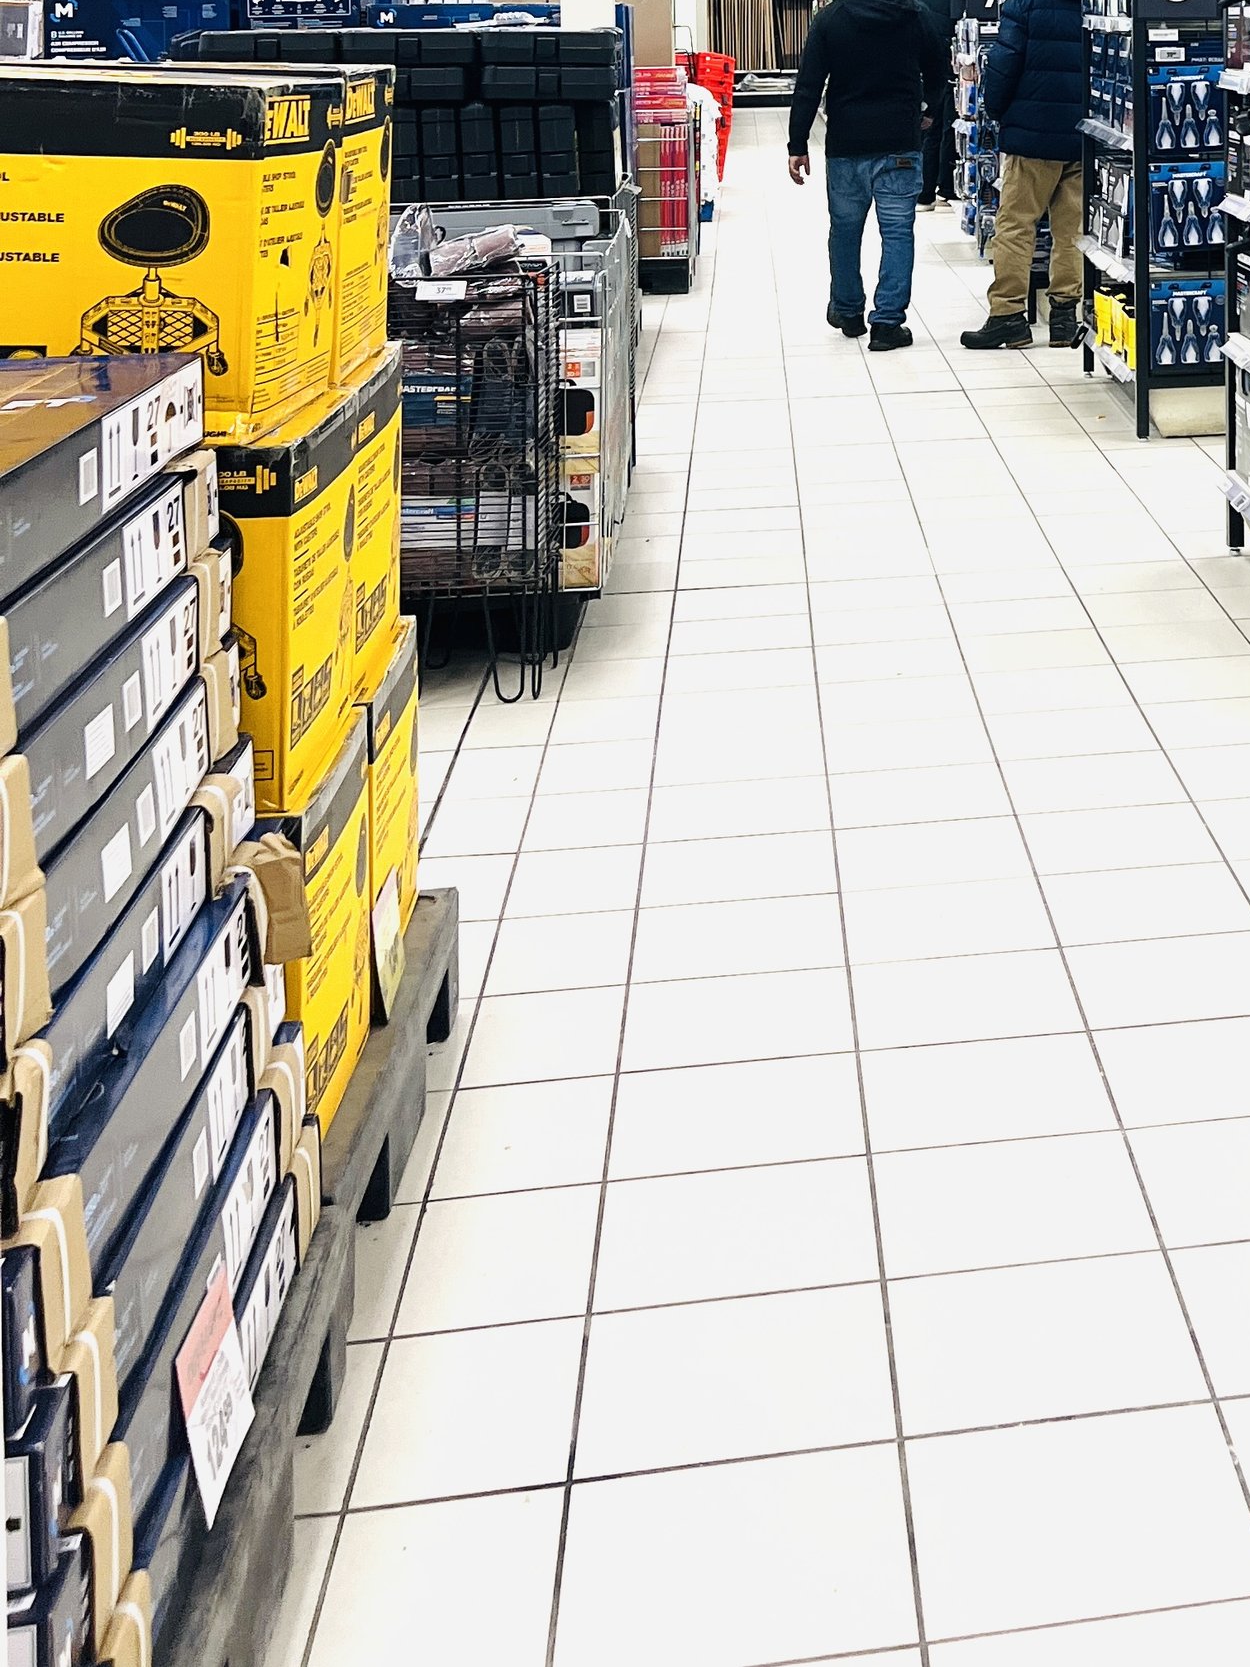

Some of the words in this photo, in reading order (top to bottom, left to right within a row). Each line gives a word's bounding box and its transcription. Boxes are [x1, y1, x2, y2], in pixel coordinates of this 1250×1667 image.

[54, 2, 74, 19] M
[378, 10, 394, 24] M
[147, 394, 161, 433] 27
[166, 497, 181, 533] 27
[183, 596, 197, 638] 27
[192, 696, 204, 738] 27
